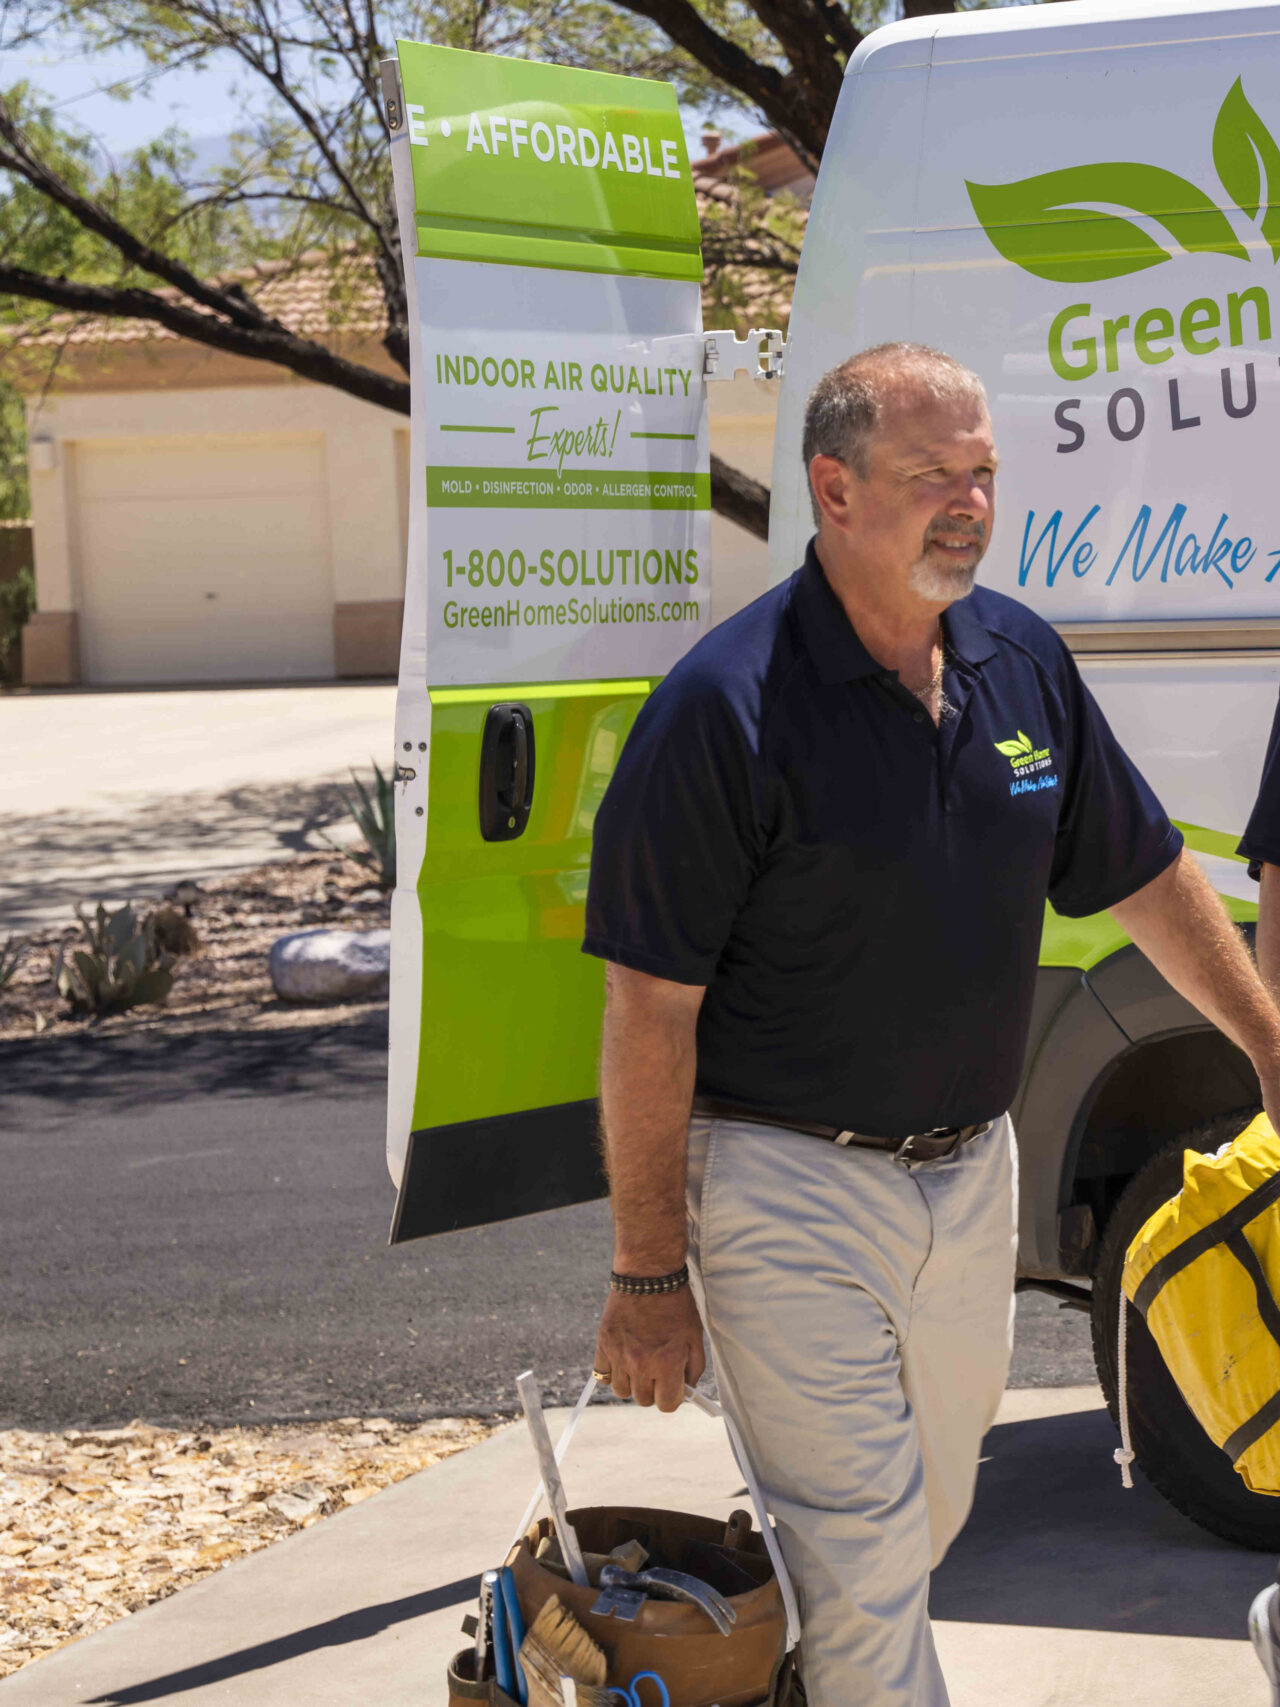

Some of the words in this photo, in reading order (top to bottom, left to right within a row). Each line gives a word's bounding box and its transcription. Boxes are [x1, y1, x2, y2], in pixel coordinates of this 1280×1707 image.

[466, 112, 681, 179] AFFORDABLE
[1048, 285, 1272, 382] Green
[436, 354, 536, 389] INDOOR
[544, 361, 584, 391] AIR
[590, 364, 692, 397] QUALITY
[526, 405, 622, 480] Experts!
[441, 480, 472, 494] MOLD
[483, 481, 554, 495] DISINFECTION
[564, 483, 592, 496] ODOR
[602, 483, 651, 497] ALLERGEN
[653, 484, 698, 498] CONTROL
[442, 549, 699, 587] 1-800-SOLUTIONS
[1018, 504, 1101, 588] We
[1105, 502, 1258, 590] Make
[443, 597, 699, 628] GreenHomeSolutions.com
